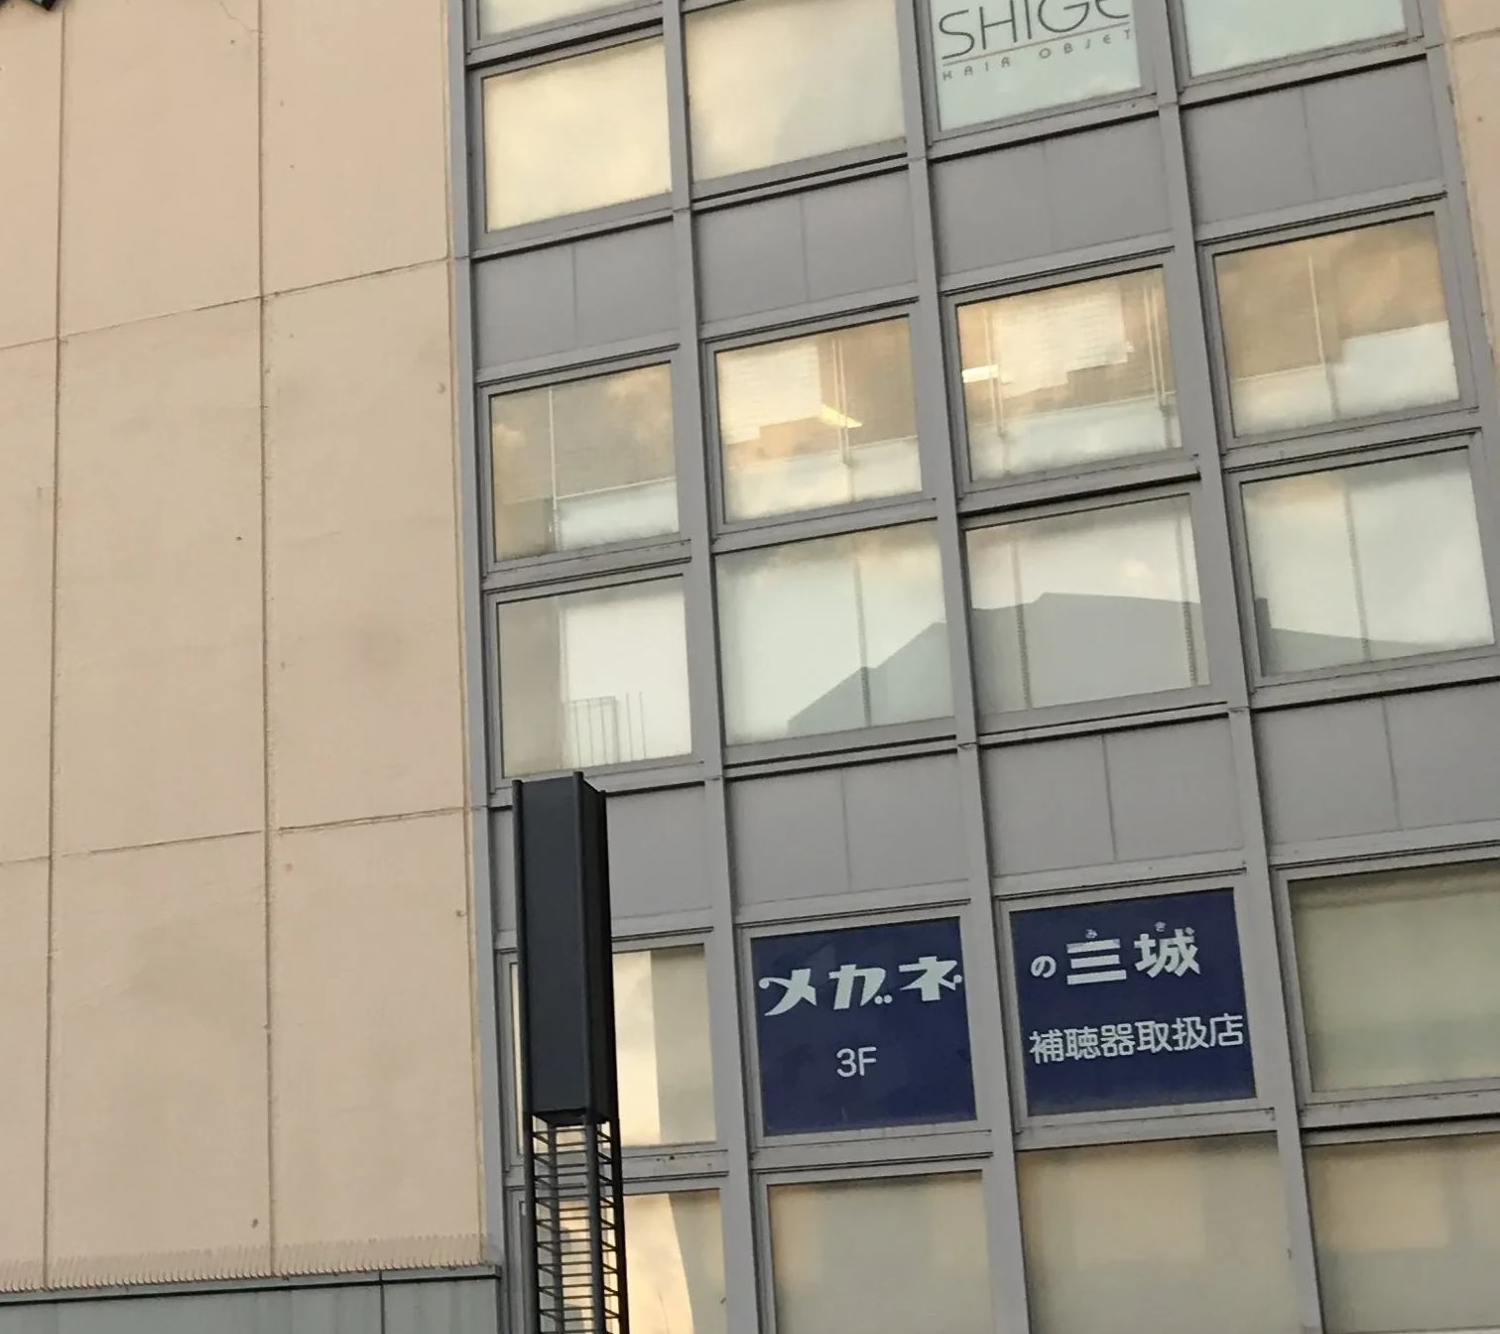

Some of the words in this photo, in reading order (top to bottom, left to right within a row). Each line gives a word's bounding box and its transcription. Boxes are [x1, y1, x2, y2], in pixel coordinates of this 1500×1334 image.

[758, 955, 963, 1017] メガネ
[836, 1046, 877, 1079] 3F
[1029, 1012, 1244, 1065] 補聴器取扱店
